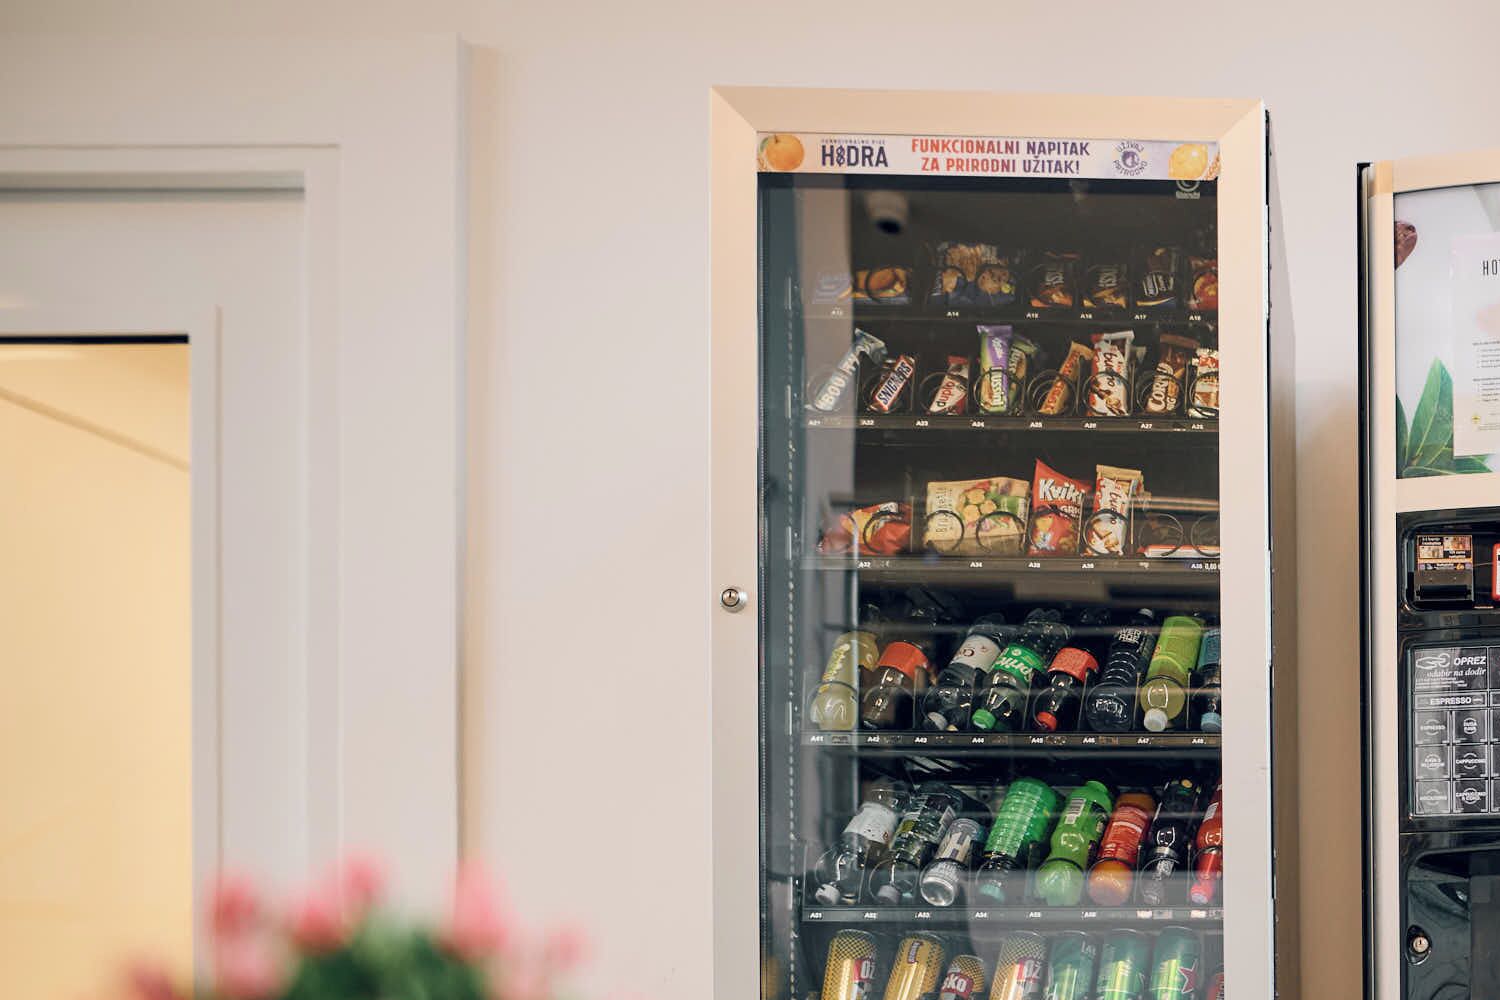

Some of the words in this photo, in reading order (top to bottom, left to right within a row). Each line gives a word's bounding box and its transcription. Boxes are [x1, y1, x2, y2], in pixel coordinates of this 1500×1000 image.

[912, 138, 1020, 154] FUNKCIONALNI
[1026, 141, 1090, 156] NAPITAK
[921, 157, 939, 172] ZA
[946, 157, 1016, 173] PRIRODNI
[1023, 155, 1080, 174] UŽITAK!
[937, 381, 956, 407] duplo
[1453, 656, 1486, 666] OPREZ
[1465, 668, 1486, 676] dodir
[1430, 697, 1472, 705] ESPRESSO
